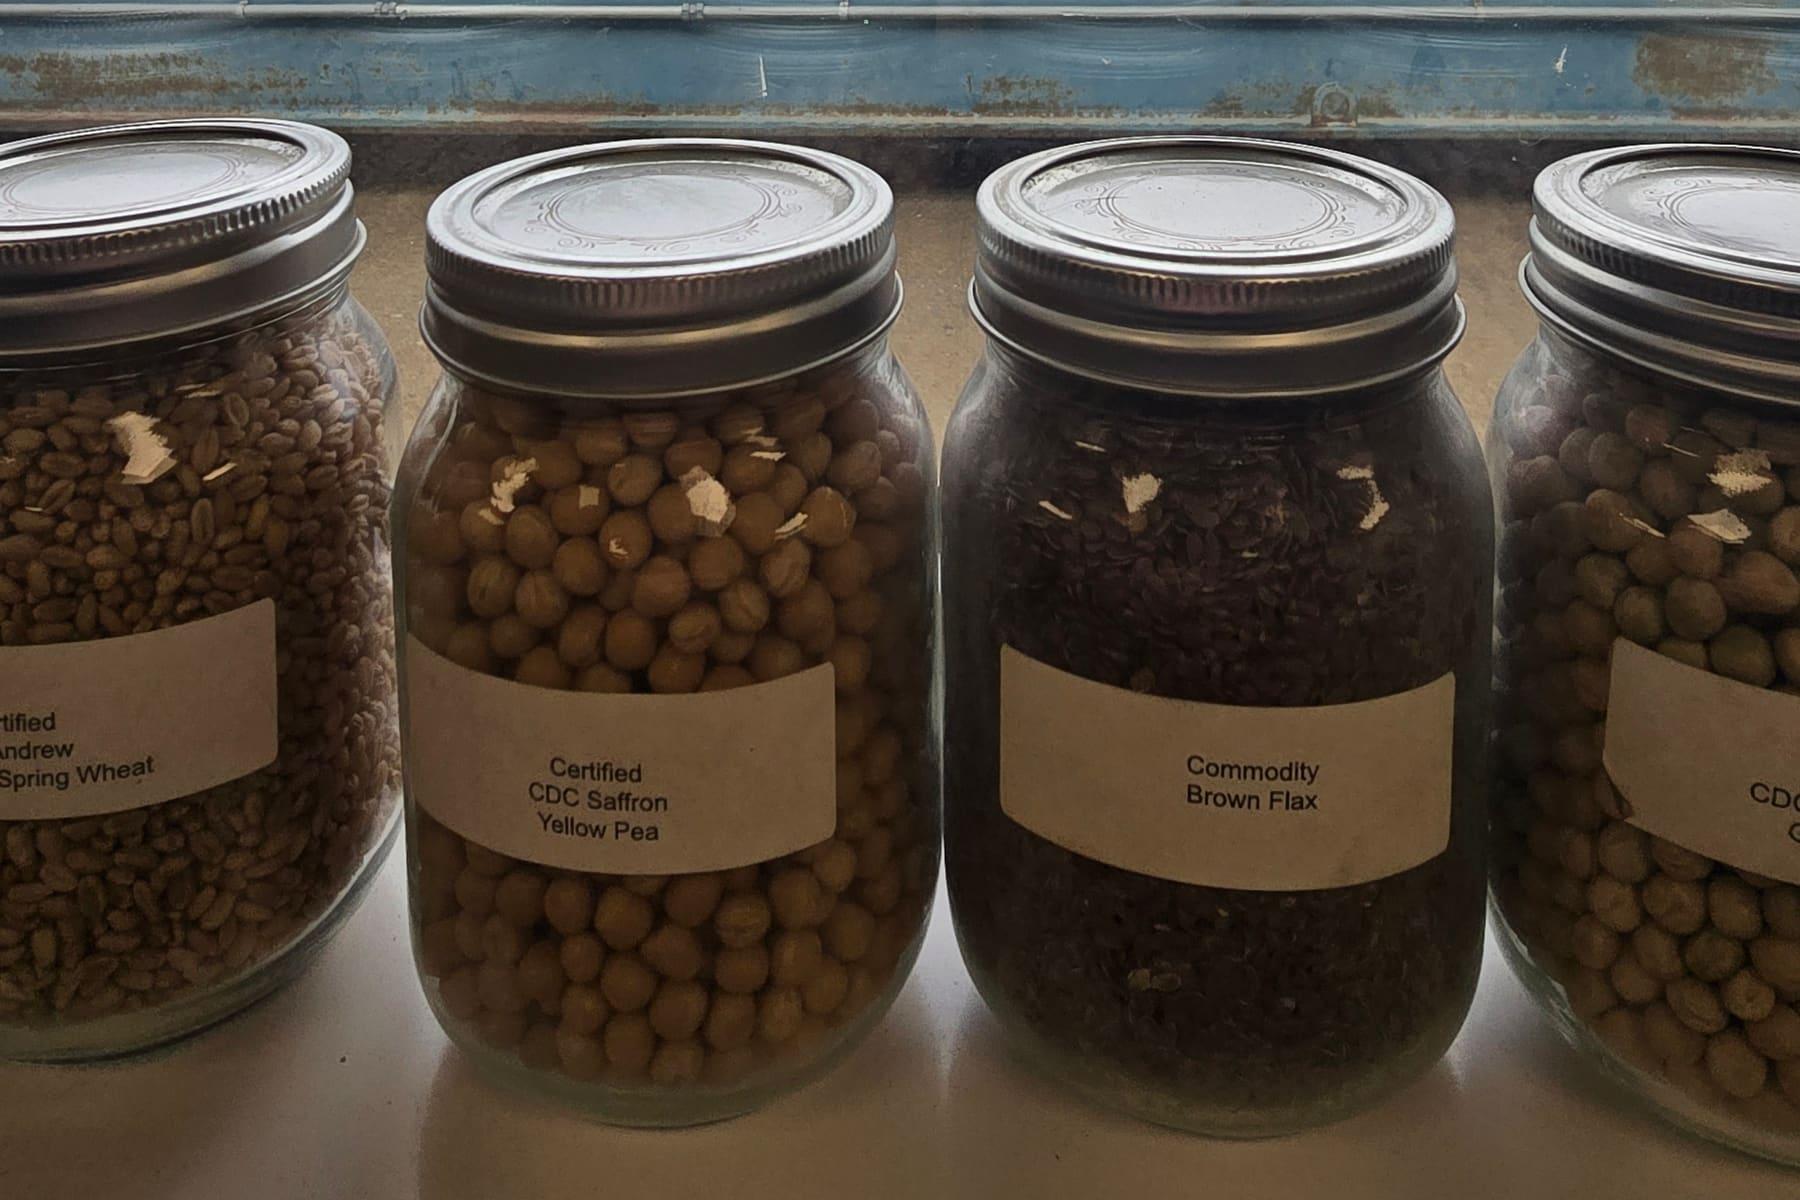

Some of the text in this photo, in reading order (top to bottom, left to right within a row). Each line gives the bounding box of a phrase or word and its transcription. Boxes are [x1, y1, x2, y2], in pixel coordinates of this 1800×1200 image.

[0, 755, 155, 792] Spring Wheat
[550, 757, 642, 783] Certified
[1187, 755, 1319, 786] Commodity
[528, 782, 668, 813] CDC Saffron
[1186, 784, 1318, 811] Brown Flax
[537, 811, 660, 842] Yellow Pea
